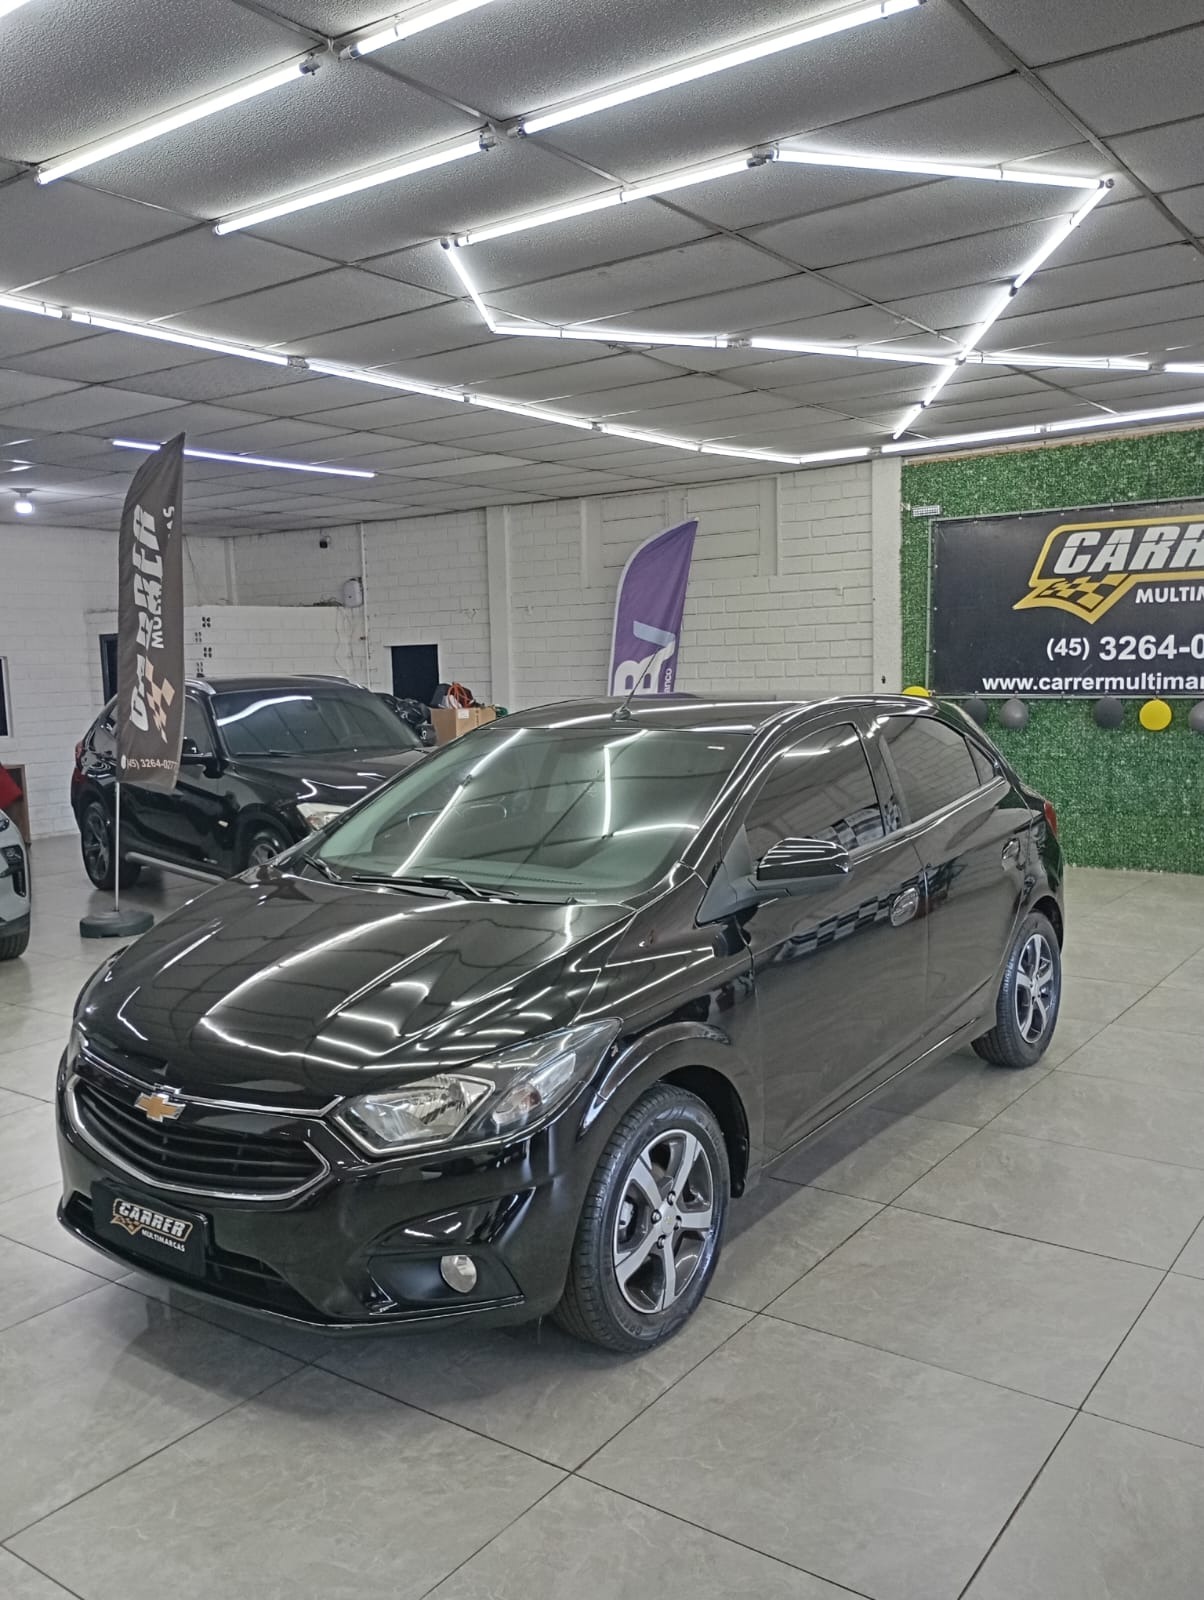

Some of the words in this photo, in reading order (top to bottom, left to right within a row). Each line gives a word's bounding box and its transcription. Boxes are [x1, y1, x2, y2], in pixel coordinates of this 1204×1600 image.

[1046, 637, 1090, 661] (45)
[1099, 634, 1204, 661] 3264-0
[663, 667, 673, 693] anco
[119, 1201, 185, 1237] CARRER
[141, 1228, 185, 1253] MULTIMARCAS
